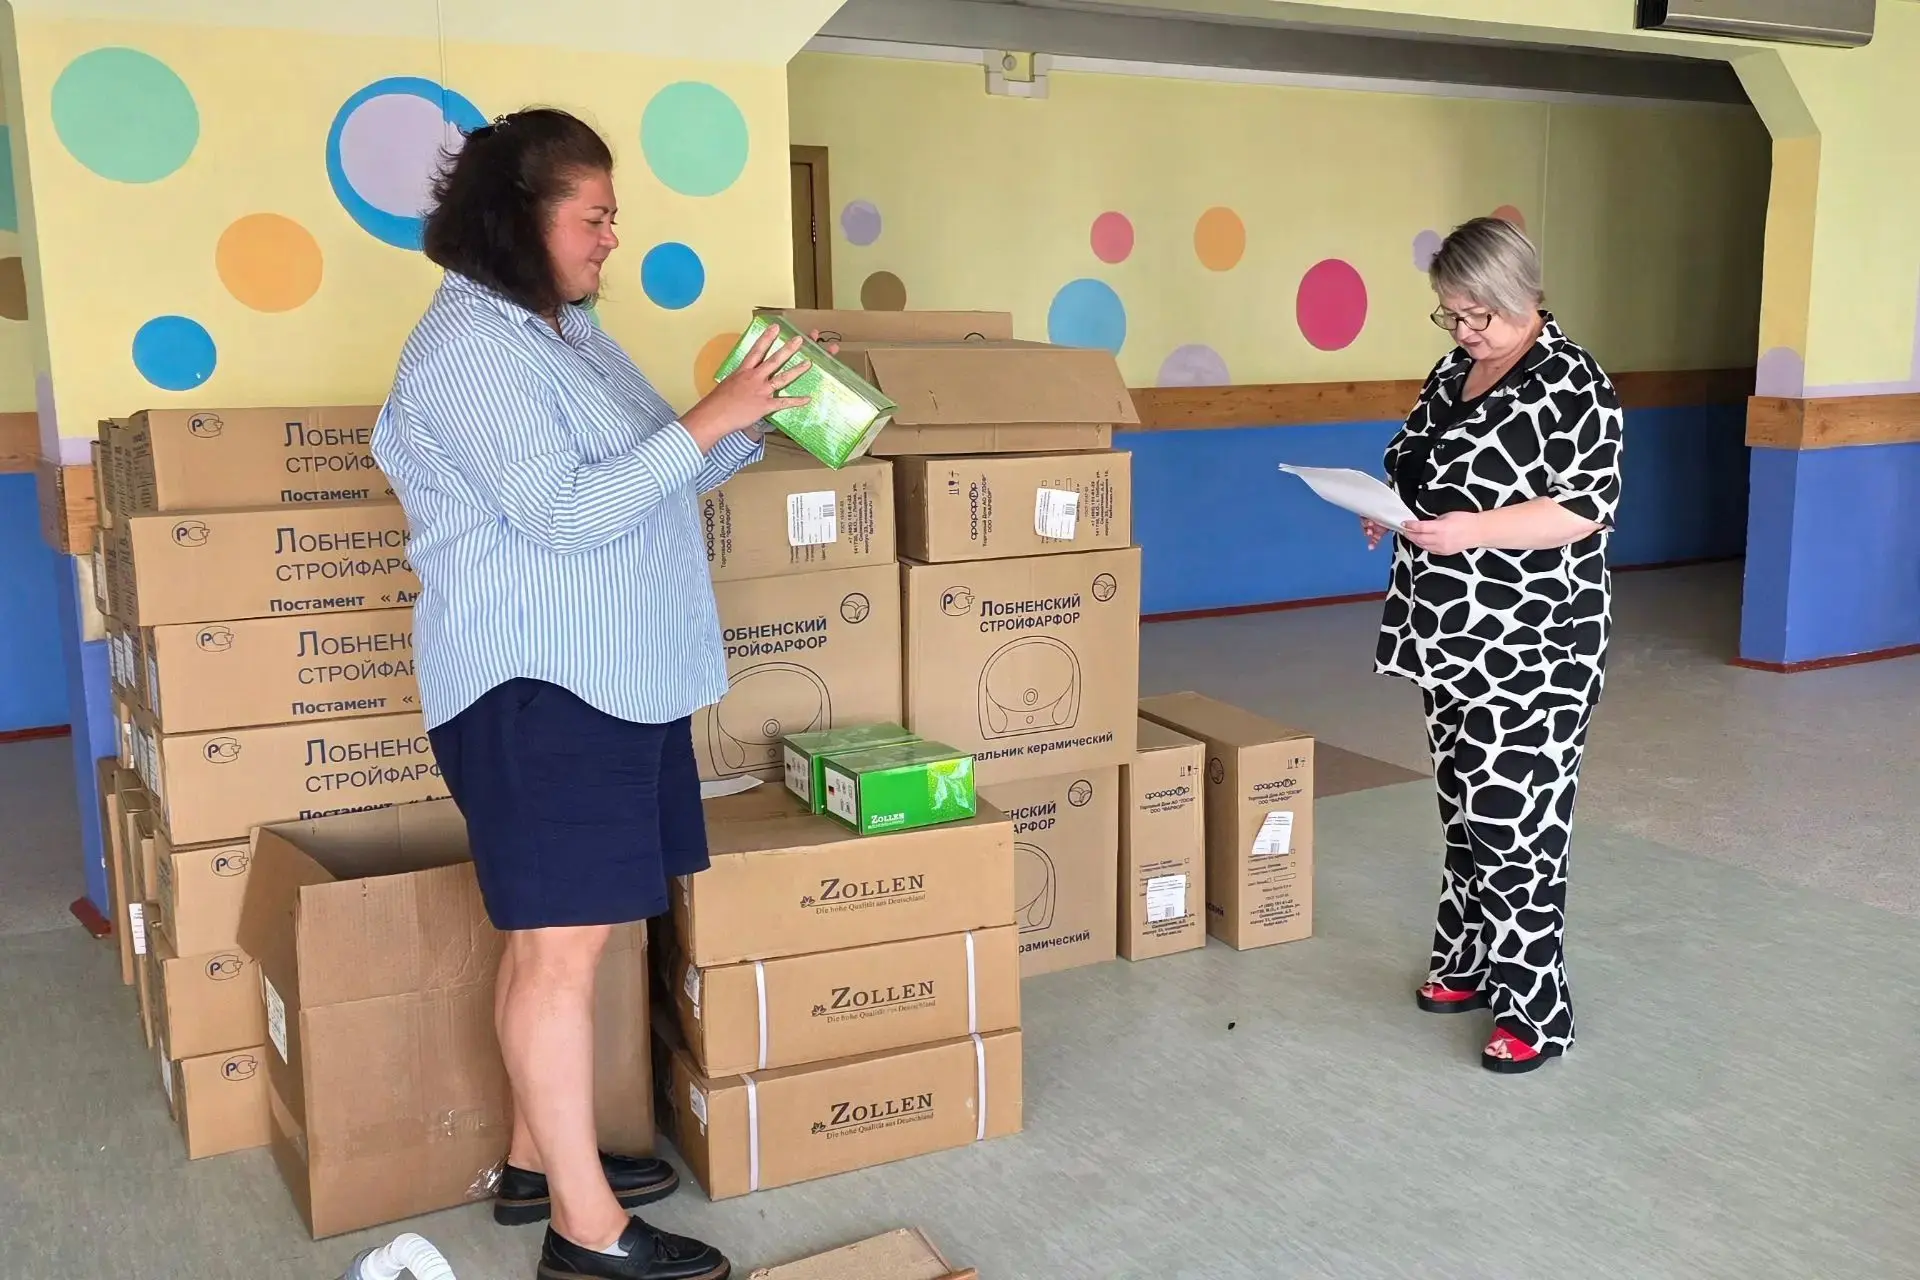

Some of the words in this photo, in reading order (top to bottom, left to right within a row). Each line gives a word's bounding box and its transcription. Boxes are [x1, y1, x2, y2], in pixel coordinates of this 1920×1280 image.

[284, 422, 373, 447] ЛОБНЕ
[286, 452, 382, 473] СТРОЙФ
[281, 488, 370, 502] Постамент
[270, 596, 365, 612] Постамент
[397, 590, 421, 603] Ан
[980, 593, 1081, 617] ЛОБНЕНСКИЙ
[723, 616, 828, 642] ОБНЕНСКИЙ
[980, 612, 1080, 633] СТРОЙФАРФОР
[723, 635, 828, 659] РОЙФАРФОР
[292, 698, 387, 715] Постамент
[1027, 731, 1113, 754] керамический
[871, 812, 905, 824] ZOLLEN
[820, 874, 925, 901] ZOLLEN
[815, 907, 829, 915] Die
[888, 894, 926, 905] Deutschland
[831, 980, 934, 1010] ZOLLEN
[827, 1015, 840, 1024] Die
[830, 1093, 933, 1126] ZOLLEN
[826, 1132, 839, 1140] Die
